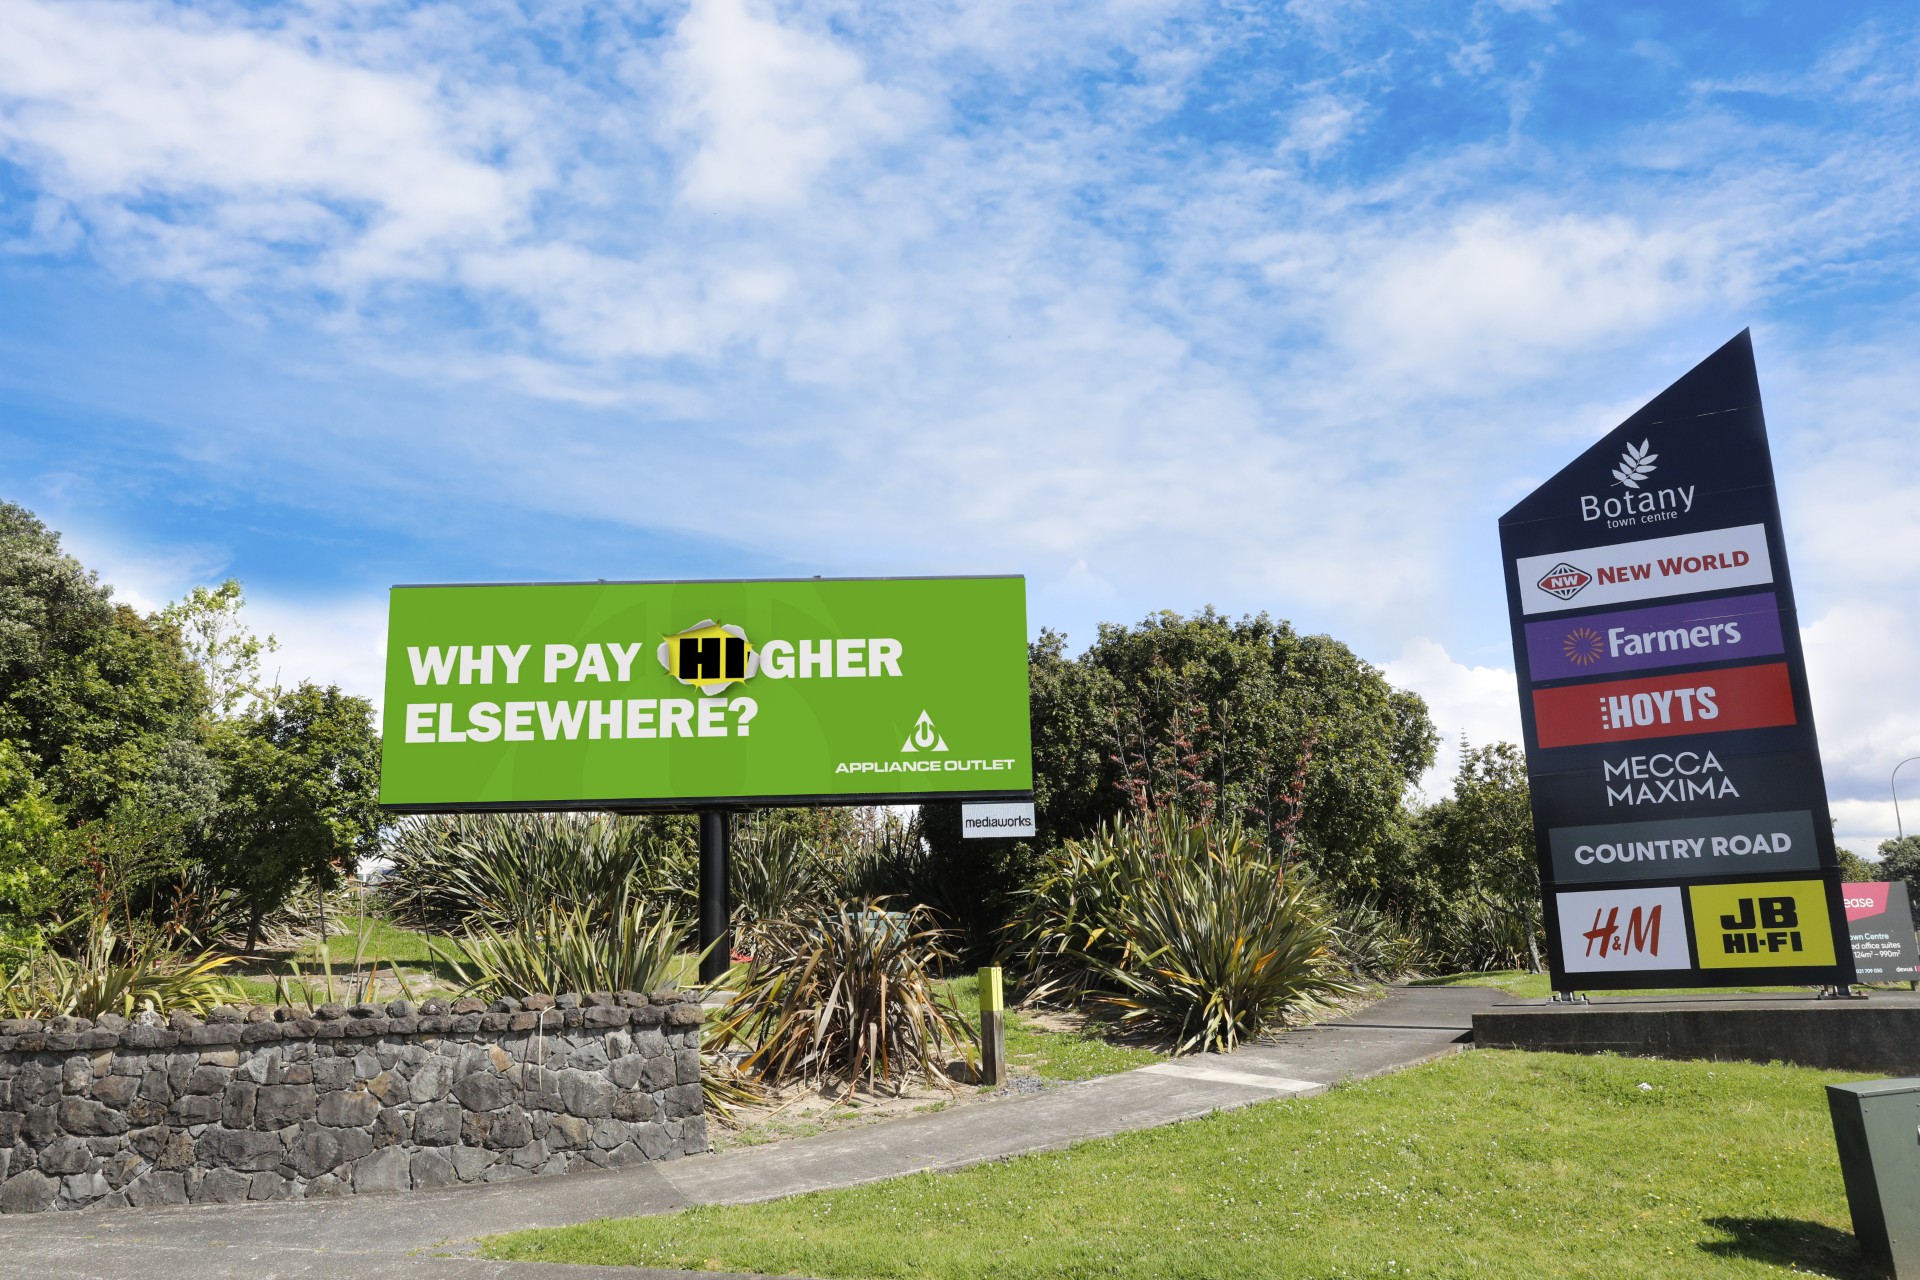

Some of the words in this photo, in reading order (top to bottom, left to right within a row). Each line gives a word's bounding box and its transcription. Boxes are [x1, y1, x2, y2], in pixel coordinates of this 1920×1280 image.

[1580, 485, 1695, 522] Botany
[1606, 517, 1636, 529] town
[1641, 510, 1678, 523] centre
[1550, 574, 1578, 588] NW
[1597, 563, 1652, 585] NEW
[1656, 550, 1749, 577] WORLD
[1607, 621, 1742, 657] Farmers
[406, 644, 532, 685] WHY
[543, 642, 642, 684] PAY
[405, 696, 758, 743] ELSEWHERE?
[1606, 686, 1719, 729] HOYTS
[835, 761, 941, 773] APPLIANCE
[944, 759, 1015, 771] OUTLET
[1603, 750, 1723, 781] MECCA
[1607, 776, 1740, 807] MAXIMA
[1574, 837, 1706, 865] COUNTRY
[1712, 832, 1792, 856] ROAD
[1720, 896, 1798, 930] JB
[1582, 904, 1662, 958] H&M
[1723, 931, 1803, 954] HI-FI
[1861, 942, 1880, 950] office
[1864, 932, 1890, 940] Centre
